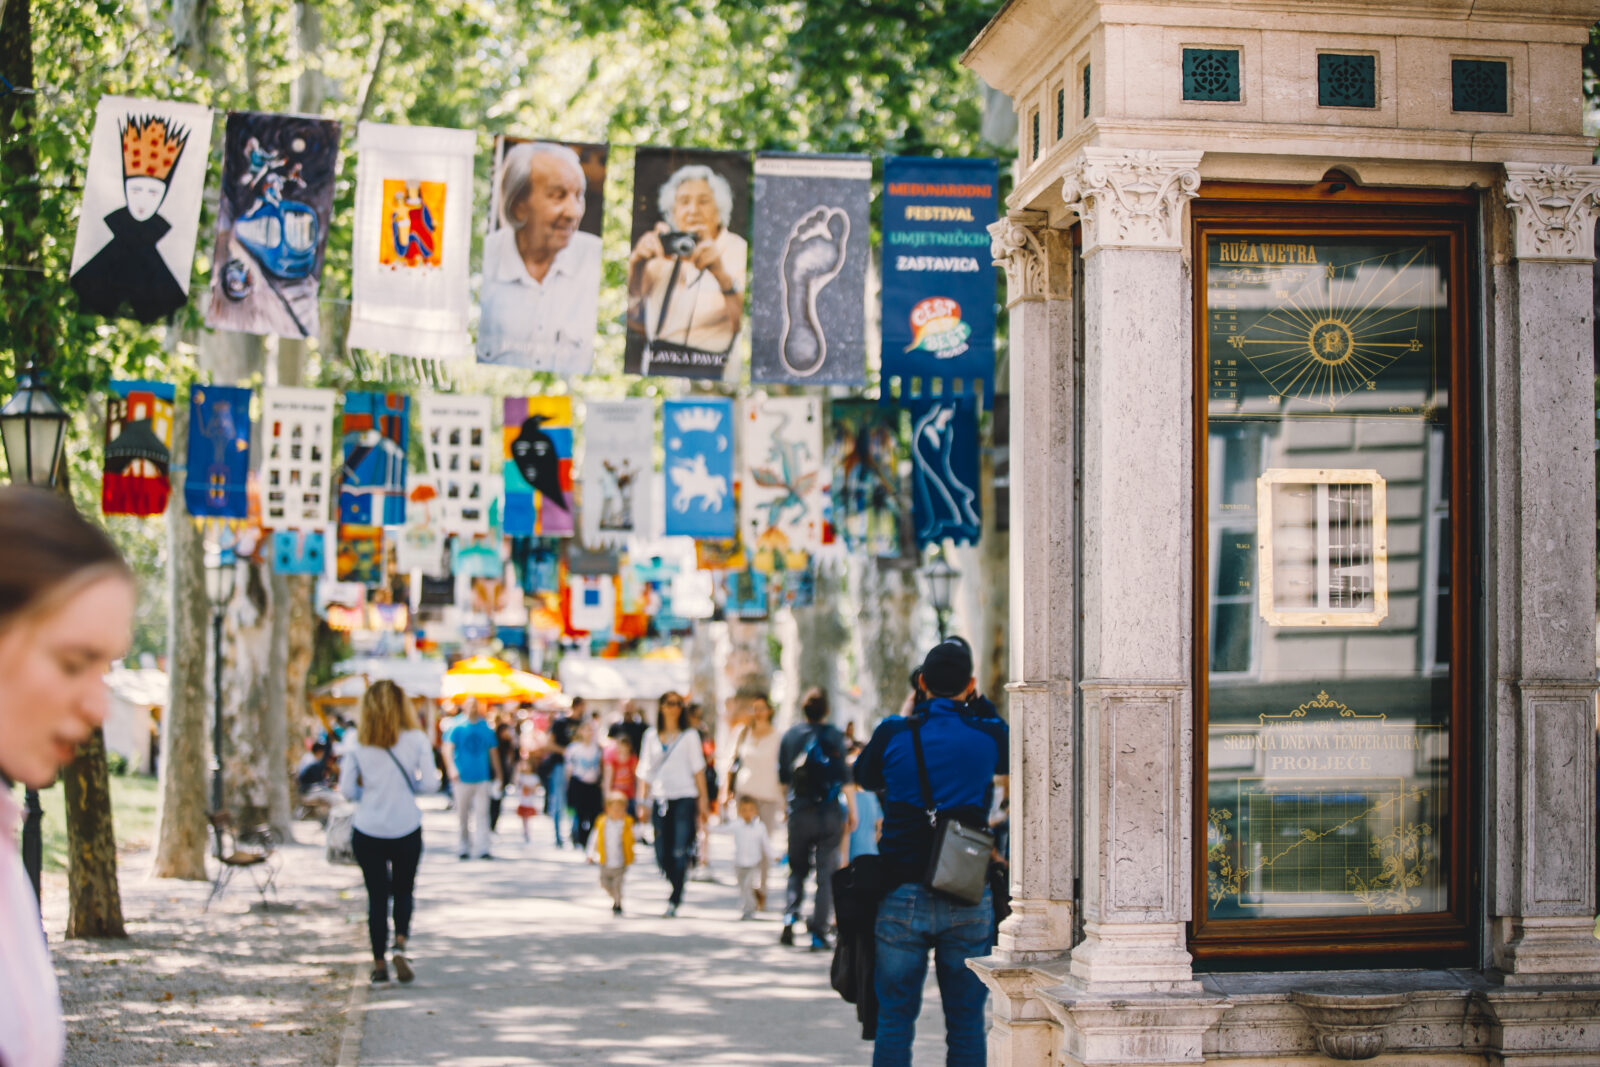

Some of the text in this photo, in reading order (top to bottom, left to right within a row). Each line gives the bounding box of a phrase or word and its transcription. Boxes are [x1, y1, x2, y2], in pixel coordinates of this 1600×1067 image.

[905, 205, 975, 222] FESTIVAL
[889, 229, 990, 248] UMJETNIČKIH
[1219, 240, 1318, 264] RUŽA VJETRA
[895, 255, 980, 272] ZASTAVICA
[1229, 336, 1245, 349] W
[1410, 339, 1420, 352] E
[1366, 381, 1377, 391] SE
[1267, 395, 1281, 405] SW
[1223, 734, 1419, 751] SREDNJA DNEVNA TEMPERATURA
[1271, 752, 1371, 770] PROLJEĆE
